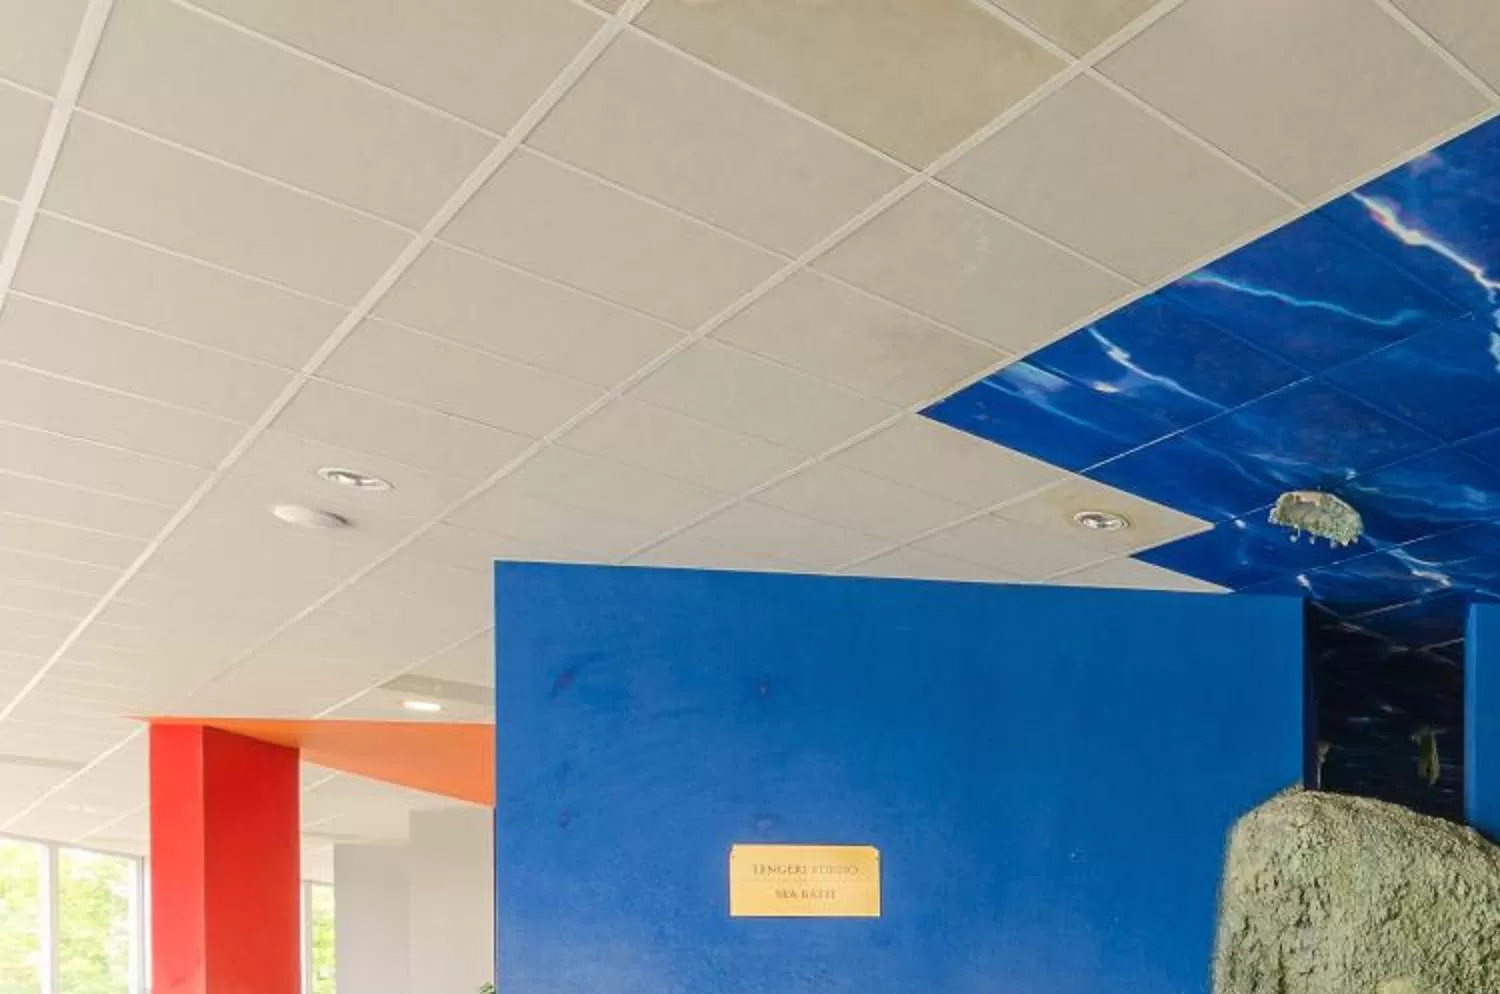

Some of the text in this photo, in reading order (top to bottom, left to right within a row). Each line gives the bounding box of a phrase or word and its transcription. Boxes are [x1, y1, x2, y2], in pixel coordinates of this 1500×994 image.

[752, 863, 807, 875] TENGERI
[775, 888, 837, 900] SEA BATH
